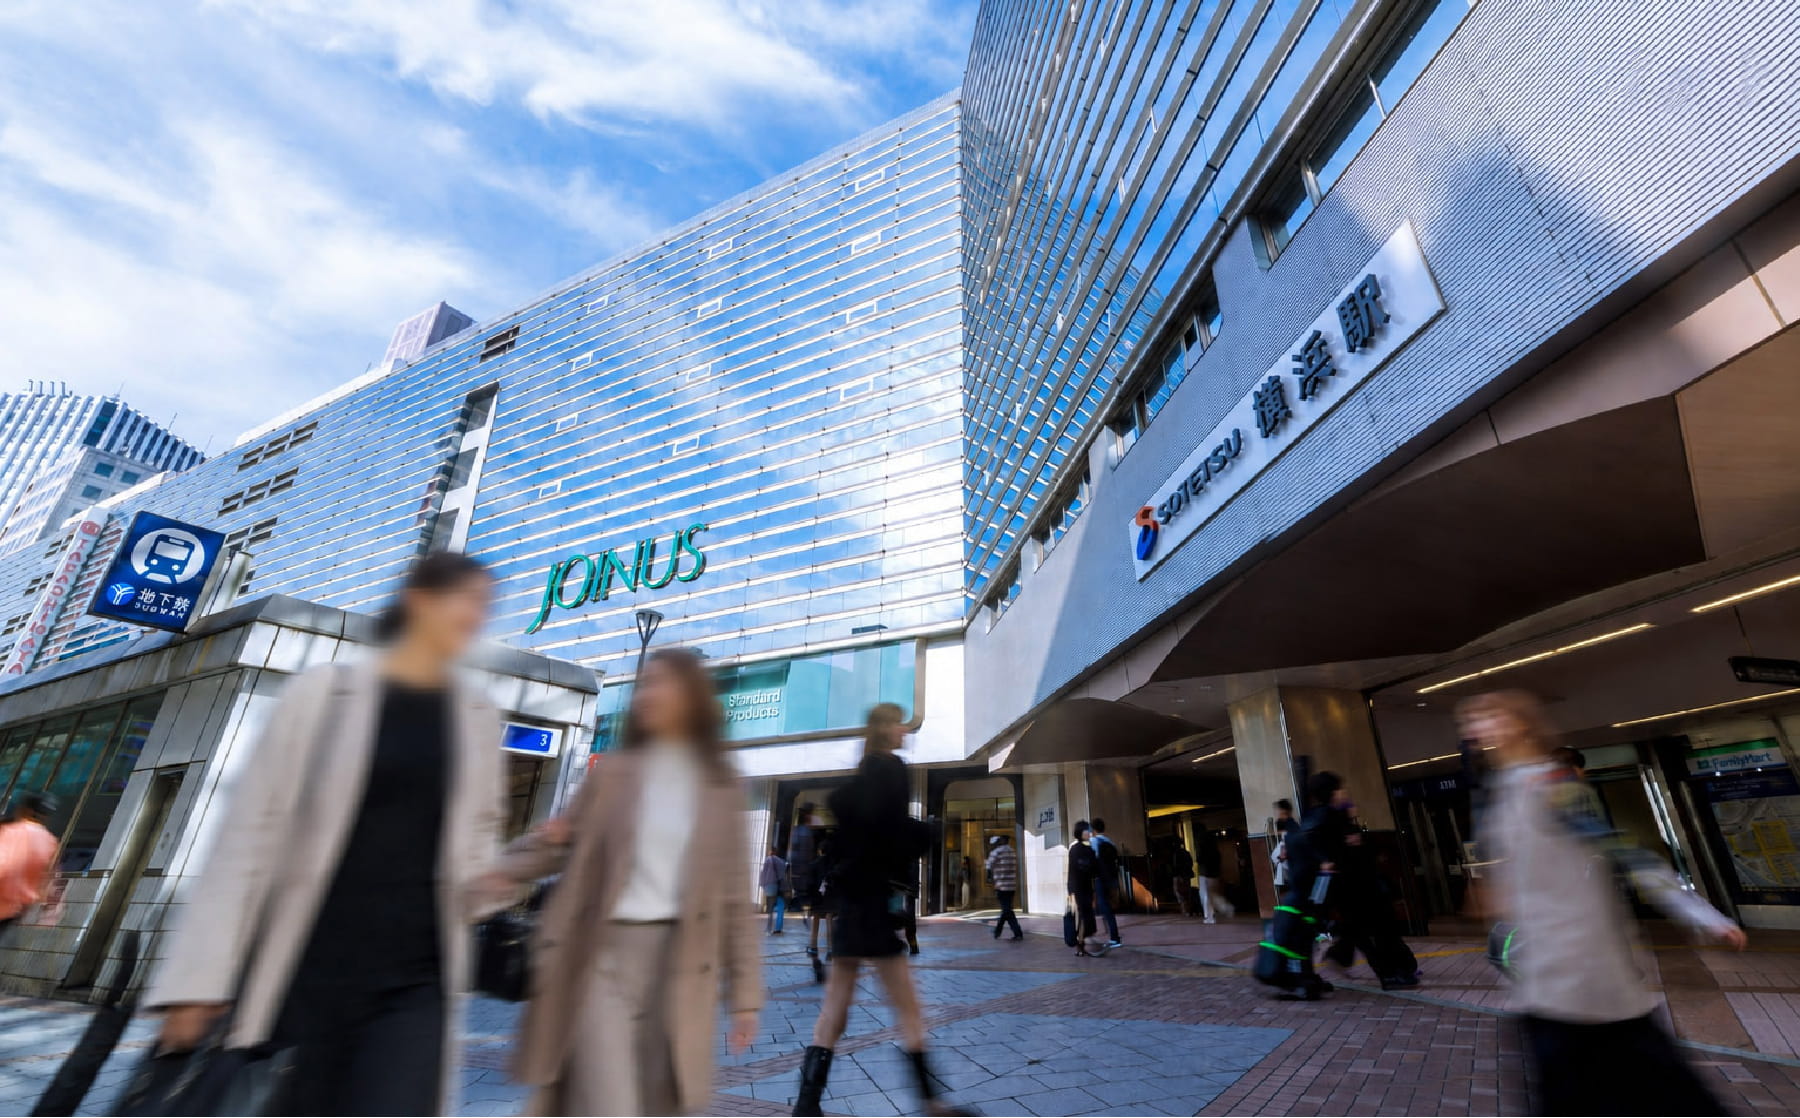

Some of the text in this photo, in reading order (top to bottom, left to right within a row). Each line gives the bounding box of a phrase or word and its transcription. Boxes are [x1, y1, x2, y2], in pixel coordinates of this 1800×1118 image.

[1158, 273, 1391, 525] SOTETSU 横浜駅
[525, 523, 709, 634] JOINUS
[728, 687, 781, 707] Standard
[725, 706, 780, 721] Products
[540, 734, 548, 746] 3
